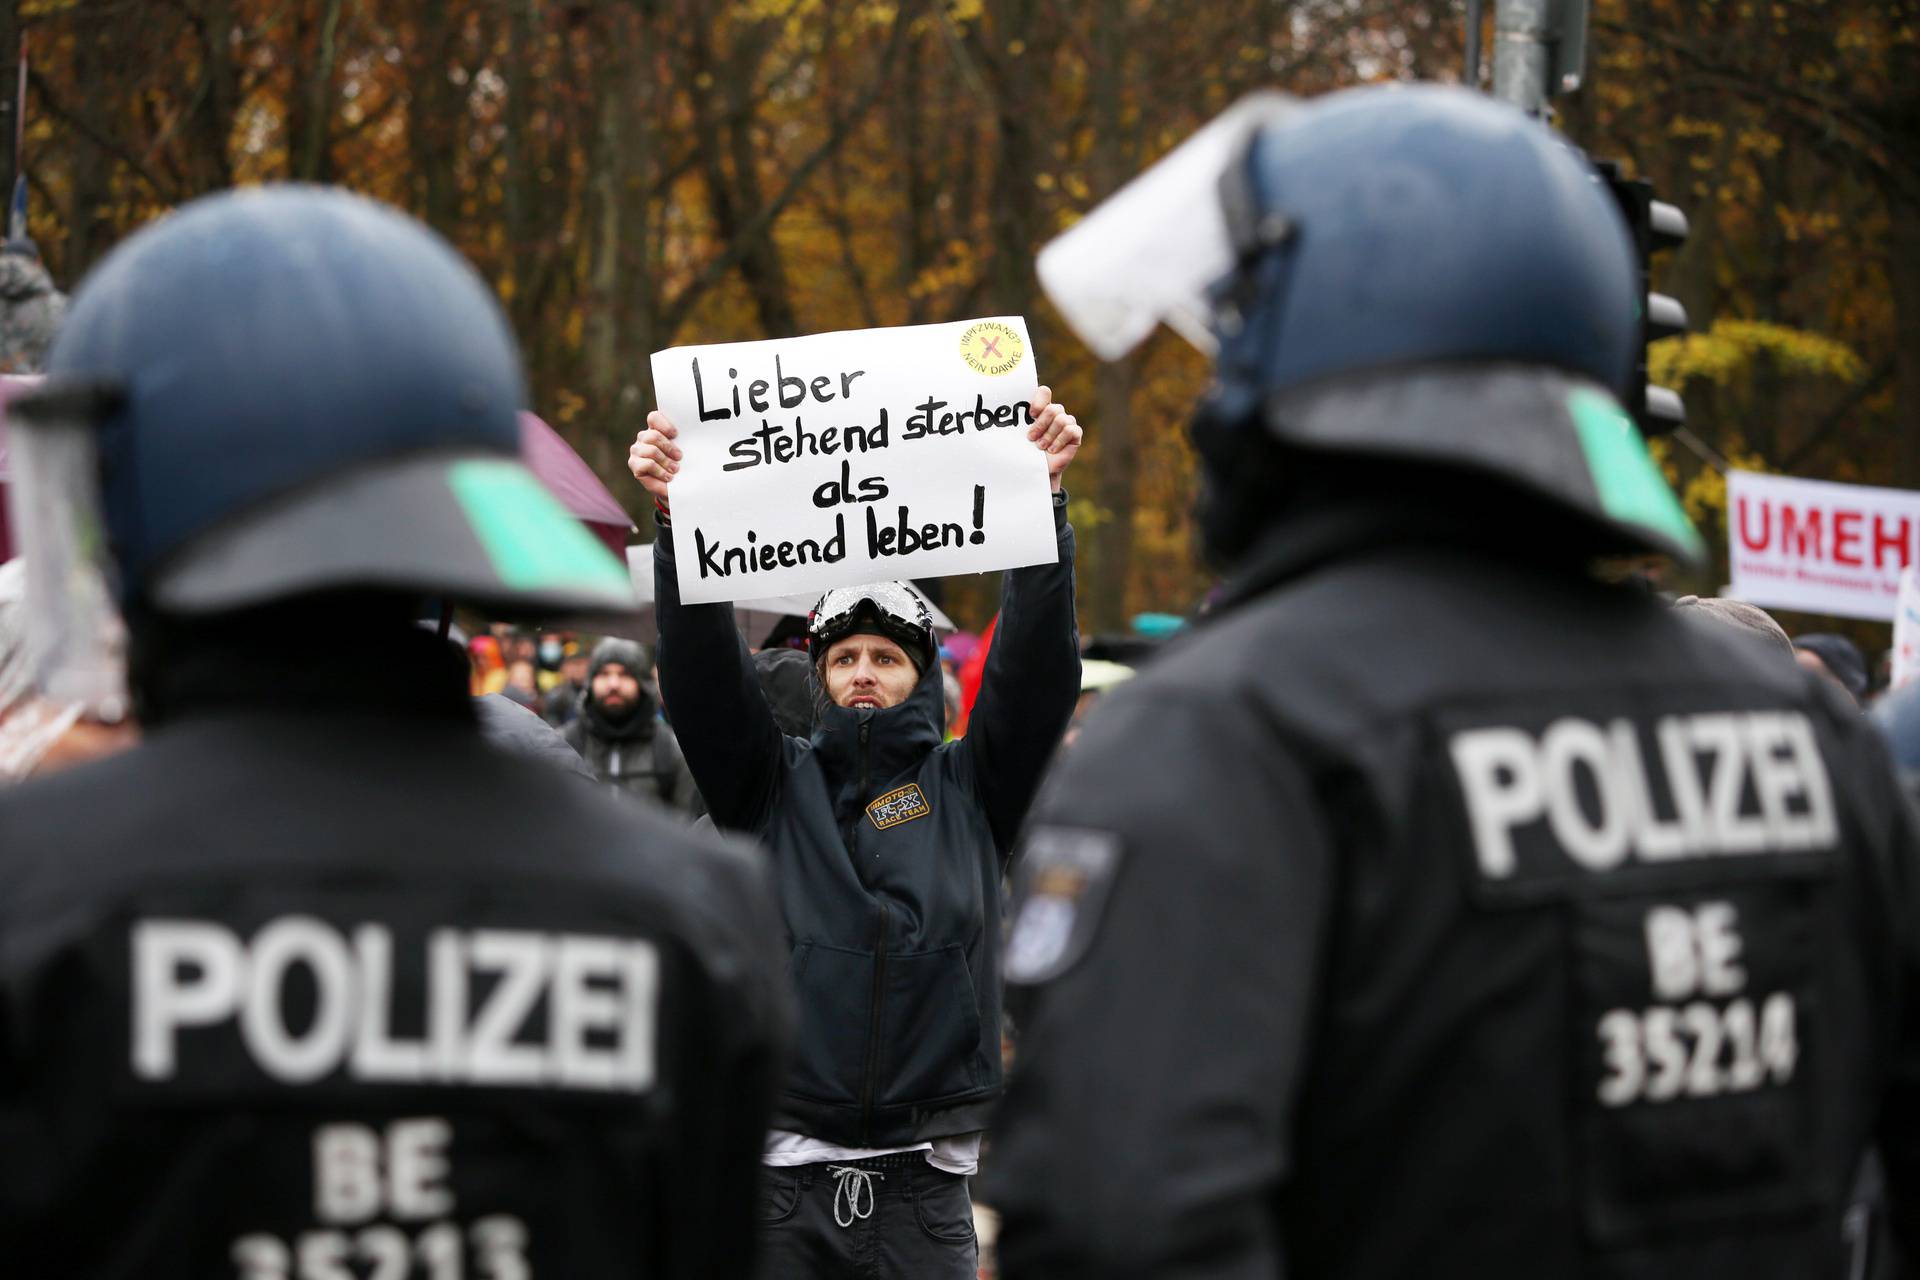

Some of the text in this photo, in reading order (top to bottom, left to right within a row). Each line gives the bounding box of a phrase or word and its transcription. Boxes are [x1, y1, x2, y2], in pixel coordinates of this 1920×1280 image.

[961, 322, 1022, 346] IMPFZWANG?
[963, 351, 1022, 375] NEIN DANKE
[692, 354, 866, 423] Lieber
[722, 393, 1035, 471] stehend sterben
[812, 460, 890, 508] als
[694, 484, 986, 579] knieend leben!
[1738, 494, 1920, 571] UMEH
[879, 804, 926, 827] RACE TEAM
[1450, 709, 1840, 878] POLIZEI
[1645, 901, 1748, 1000] BE
[130, 914, 659, 1092] POLIZEI
[1597, 992, 1799, 1108] 35214
[313, 1117, 456, 1225] BE
